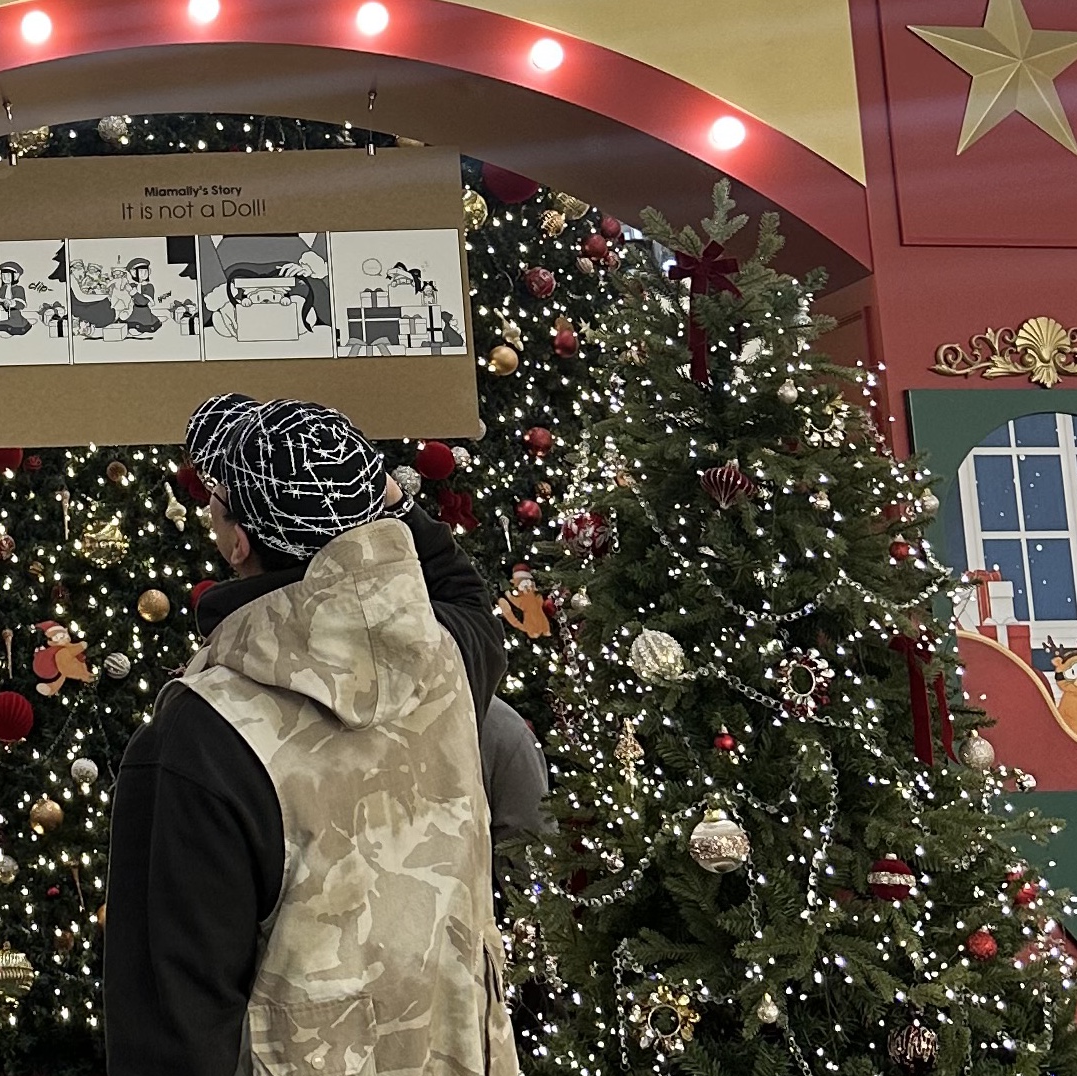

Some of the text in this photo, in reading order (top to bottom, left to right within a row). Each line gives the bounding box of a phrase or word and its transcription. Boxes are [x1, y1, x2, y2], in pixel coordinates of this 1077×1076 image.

[144, 184, 243, 198] Miamally's Story
[122, 199, 267, 220] It is not a Doll!
